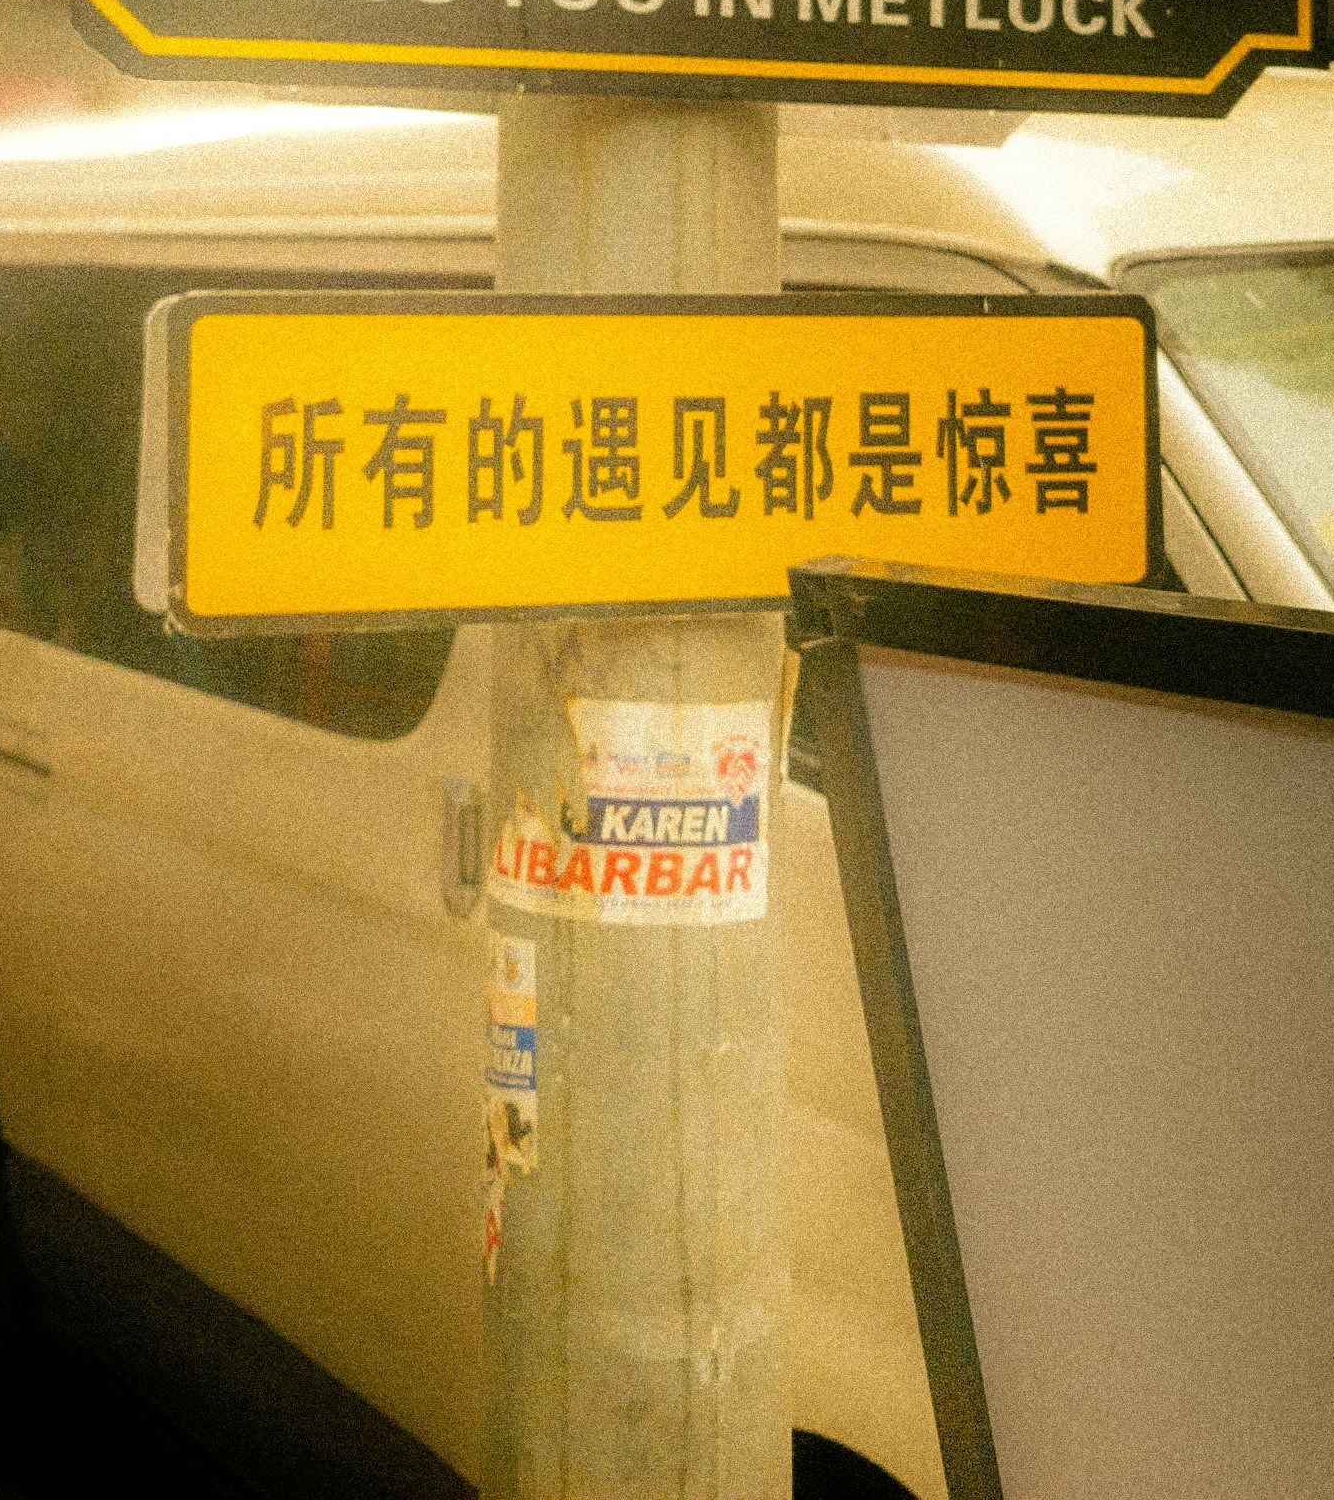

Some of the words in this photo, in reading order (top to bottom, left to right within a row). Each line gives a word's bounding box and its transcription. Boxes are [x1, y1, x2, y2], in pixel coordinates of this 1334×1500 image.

[253, 386, 1099, 530] 所有的遇见都是惊喜
[601, 804, 729, 843] KAREN
